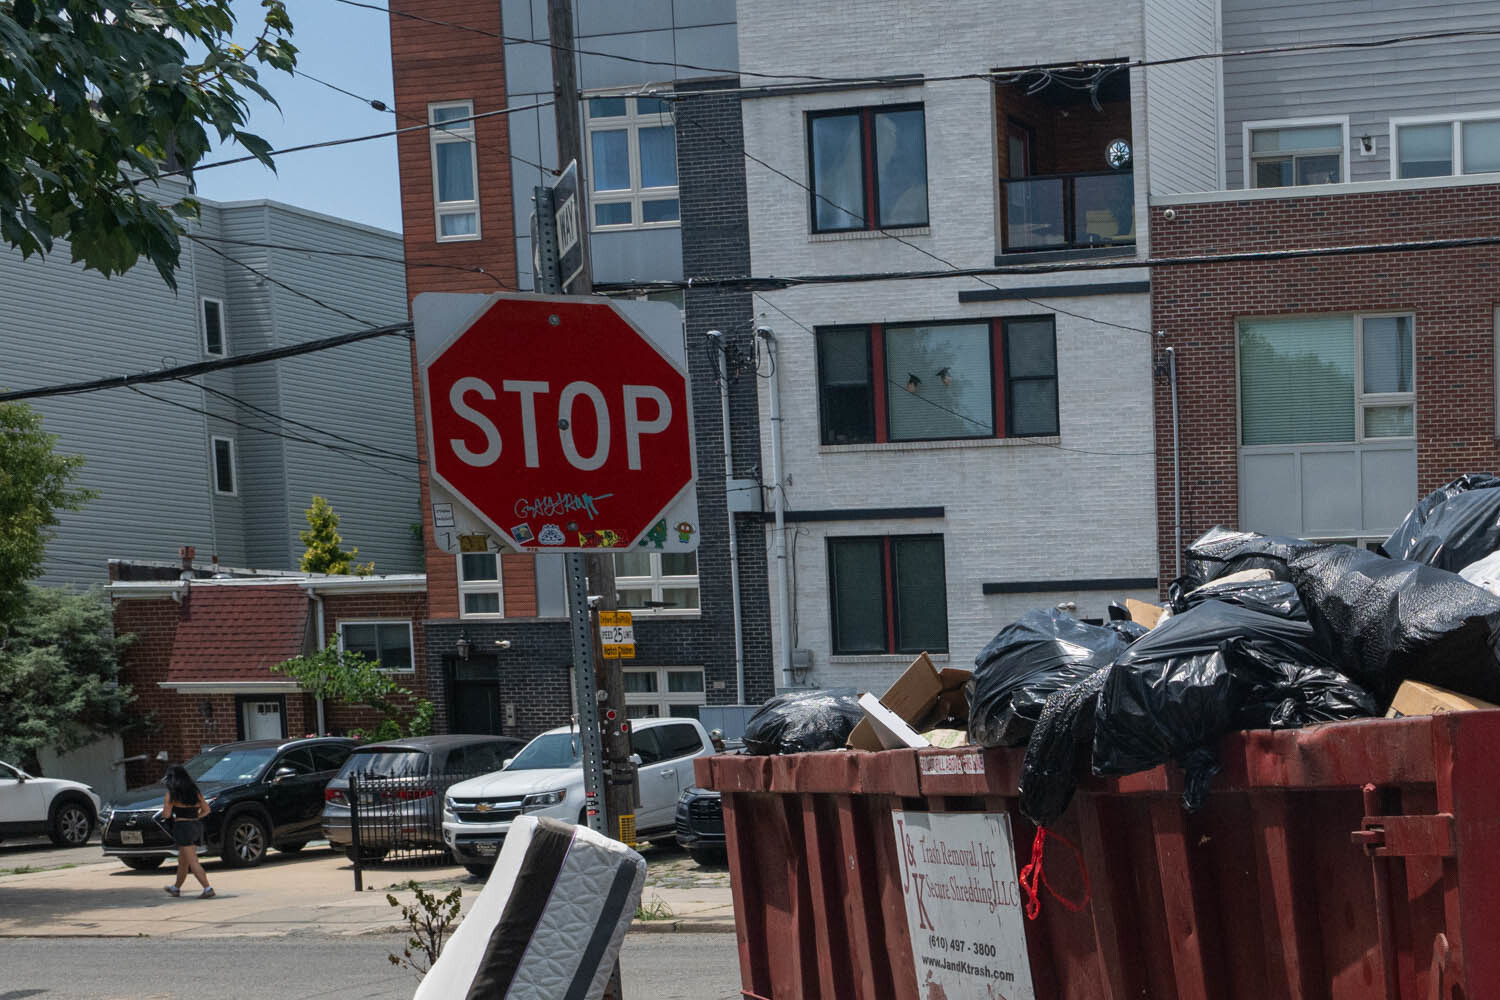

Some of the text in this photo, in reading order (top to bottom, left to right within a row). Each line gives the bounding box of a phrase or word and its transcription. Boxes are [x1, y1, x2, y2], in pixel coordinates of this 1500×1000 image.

[559, 202, 575, 249] WAY
[448, 376, 673, 471] STOP
[613, 627, 623, 642] 25
[920, 836, 941, 865] Trash
[912, 872, 935, 932] K
[926, 875, 951, 901] Secure
[994, 880, 1019, 908] LLC
[929, 935, 949, 953] (610)
[950, 940, 966, 953] 497
[973, 942, 997, 958] 3800
[921, 955, 1015, 983] www.JandKtrash.com
